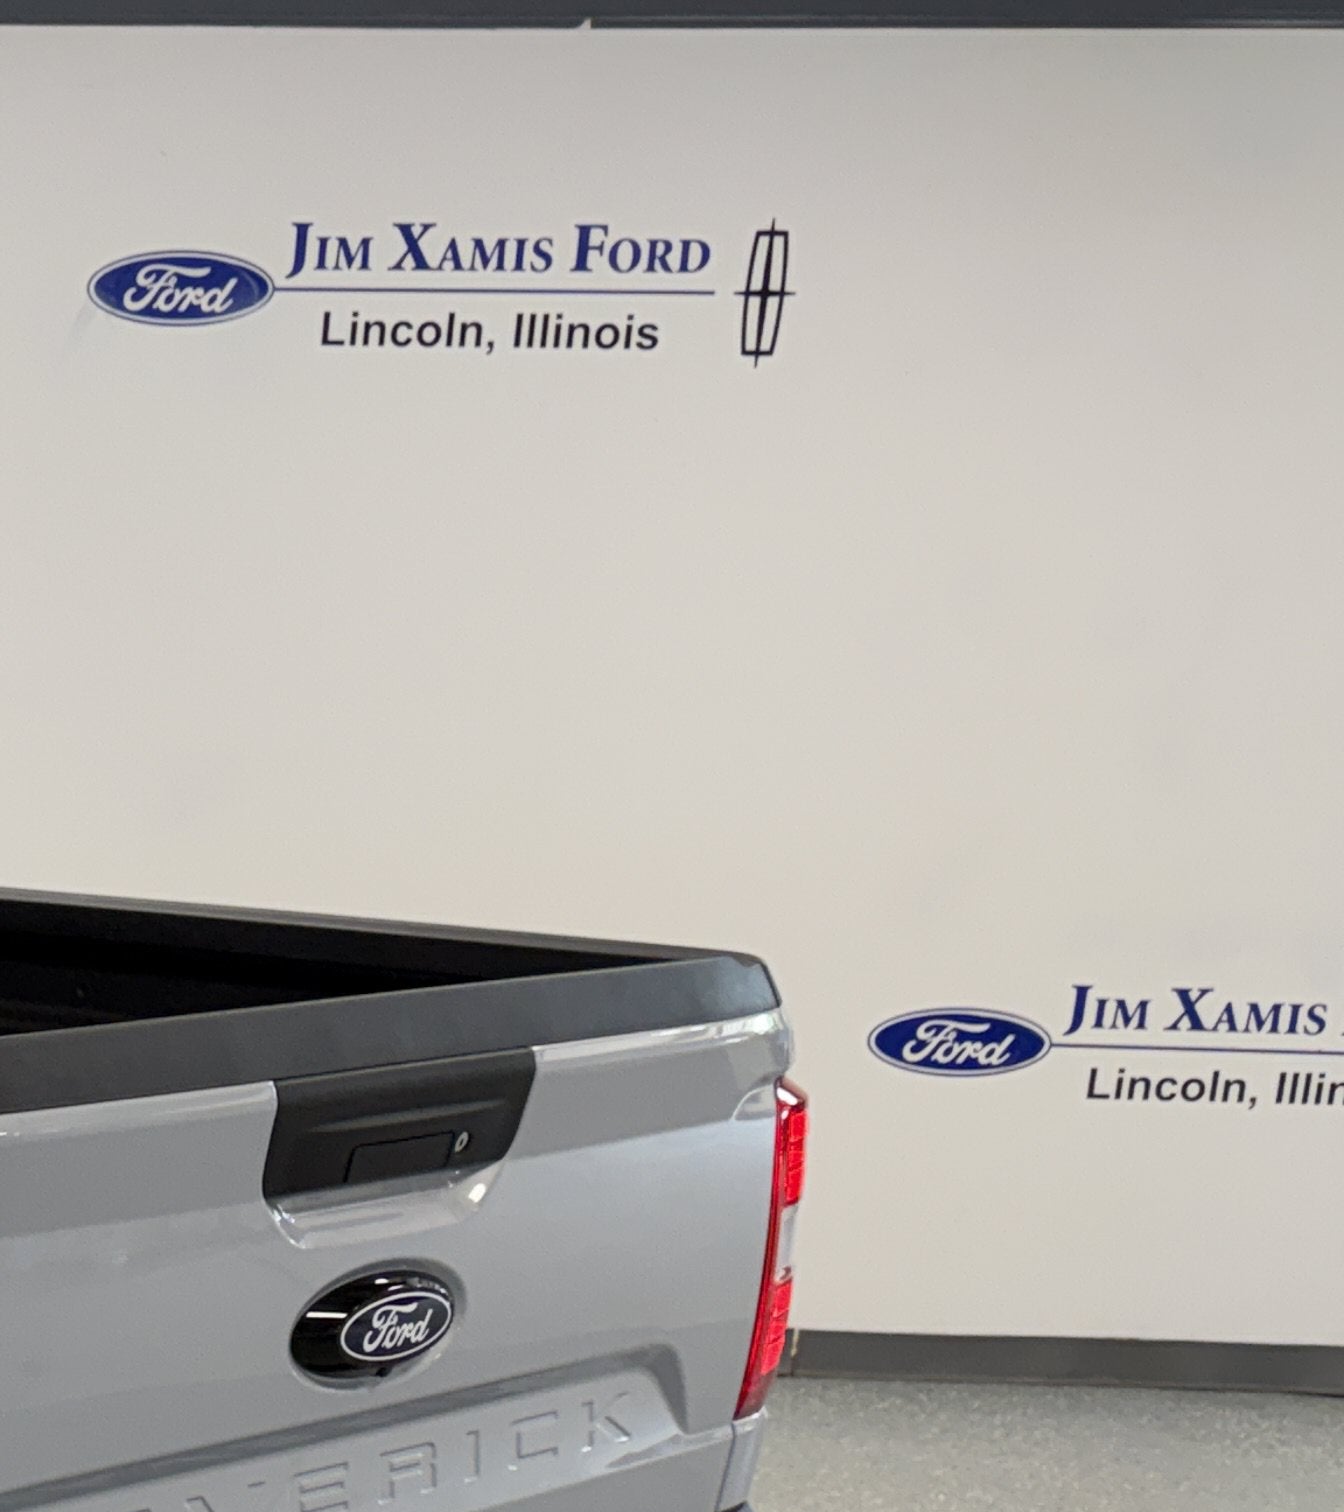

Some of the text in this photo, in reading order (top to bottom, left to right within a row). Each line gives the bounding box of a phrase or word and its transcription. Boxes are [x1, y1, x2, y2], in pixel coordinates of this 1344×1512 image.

[285, 222, 711, 279] JIM XAMIS FORD
[123, 263, 238, 313] Ford
[321, 311, 659, 354] Lincoln, Illinois
[1063, 984, 1328, 1036] JIM XAMIS
[902, 1019, 1016, 1065] Ford
[1086, 1067, 1257, 1110] Lincoln,
[363, 1302, 433, 1353] Ford
